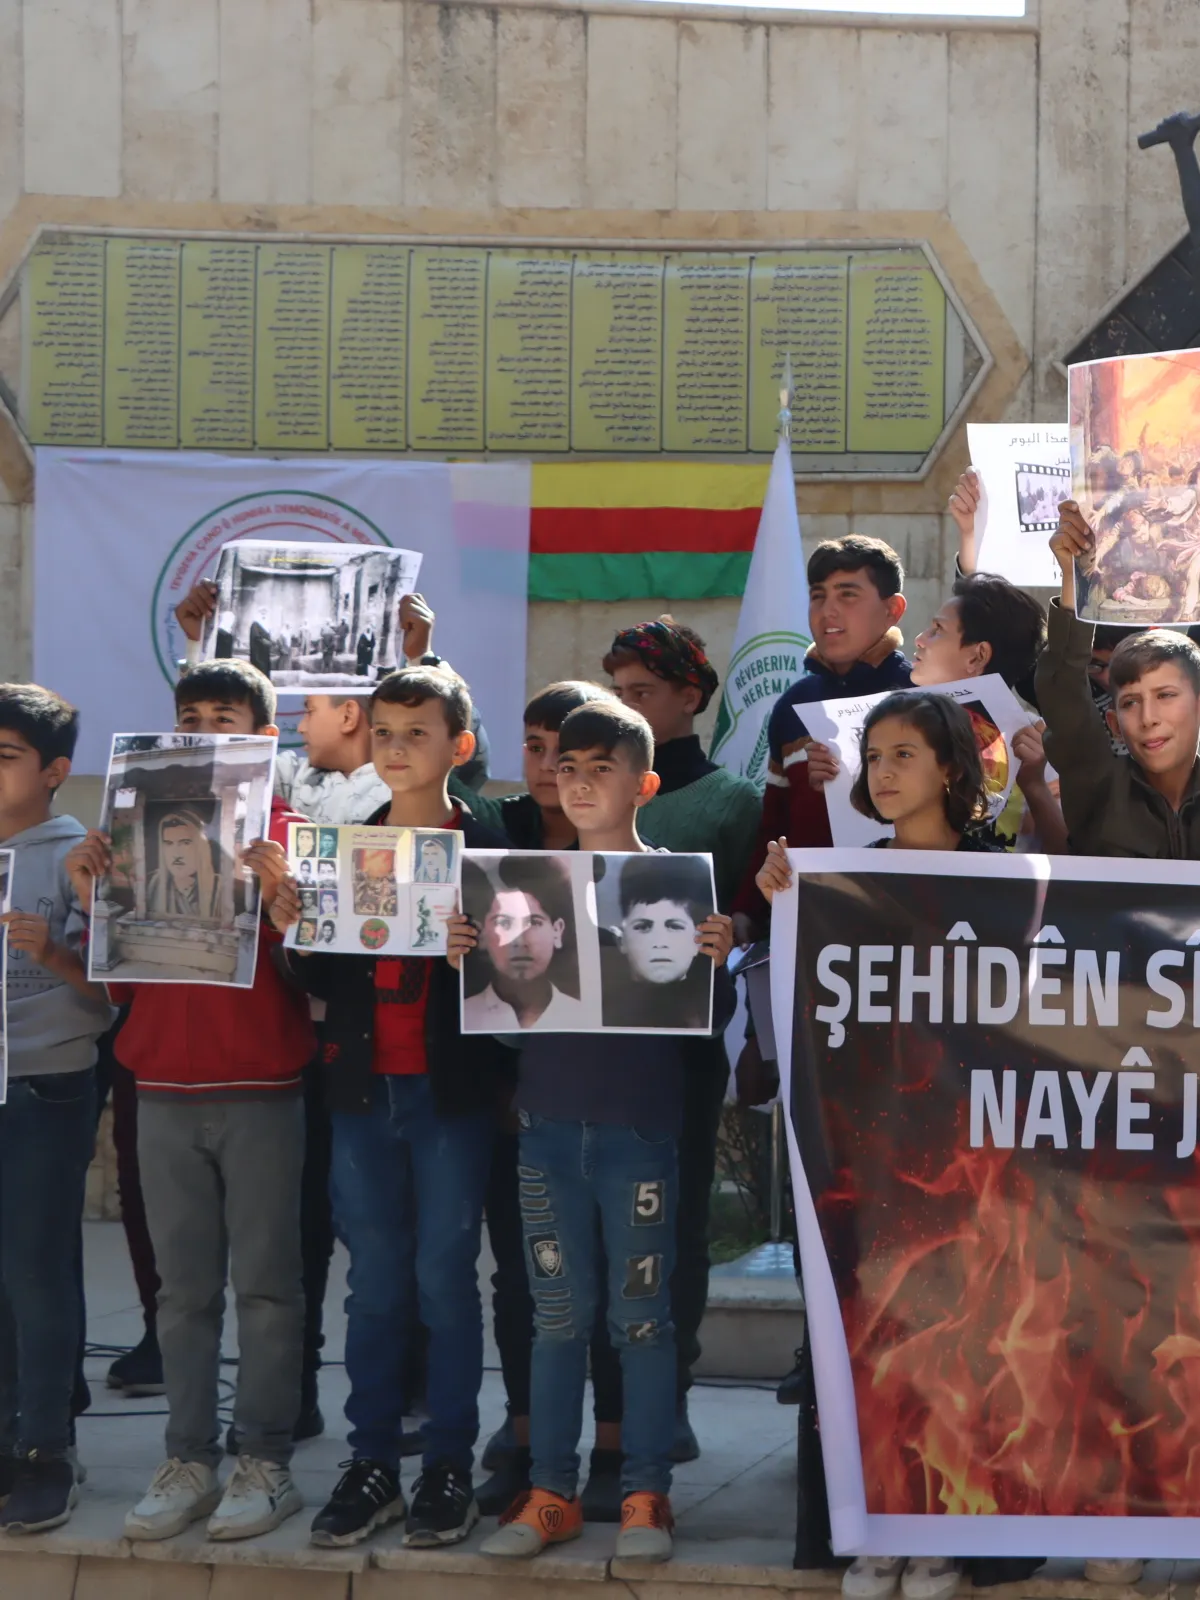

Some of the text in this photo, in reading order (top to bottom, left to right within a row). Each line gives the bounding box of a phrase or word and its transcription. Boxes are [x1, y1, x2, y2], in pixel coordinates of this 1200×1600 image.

[1008, 432, 1040, 447] اليوم
[734, 654, 797, 691] RÊVEBERIYA
[815, 921, 1121, 1048] ŞEHÎDÊN
[970, 1046, 1155, 1150] NAYÊ
[637, 1182, 660, 1217] 5
[637, 1256, 655, 1284] 1
[545, 1509, 560, 1528] 90
